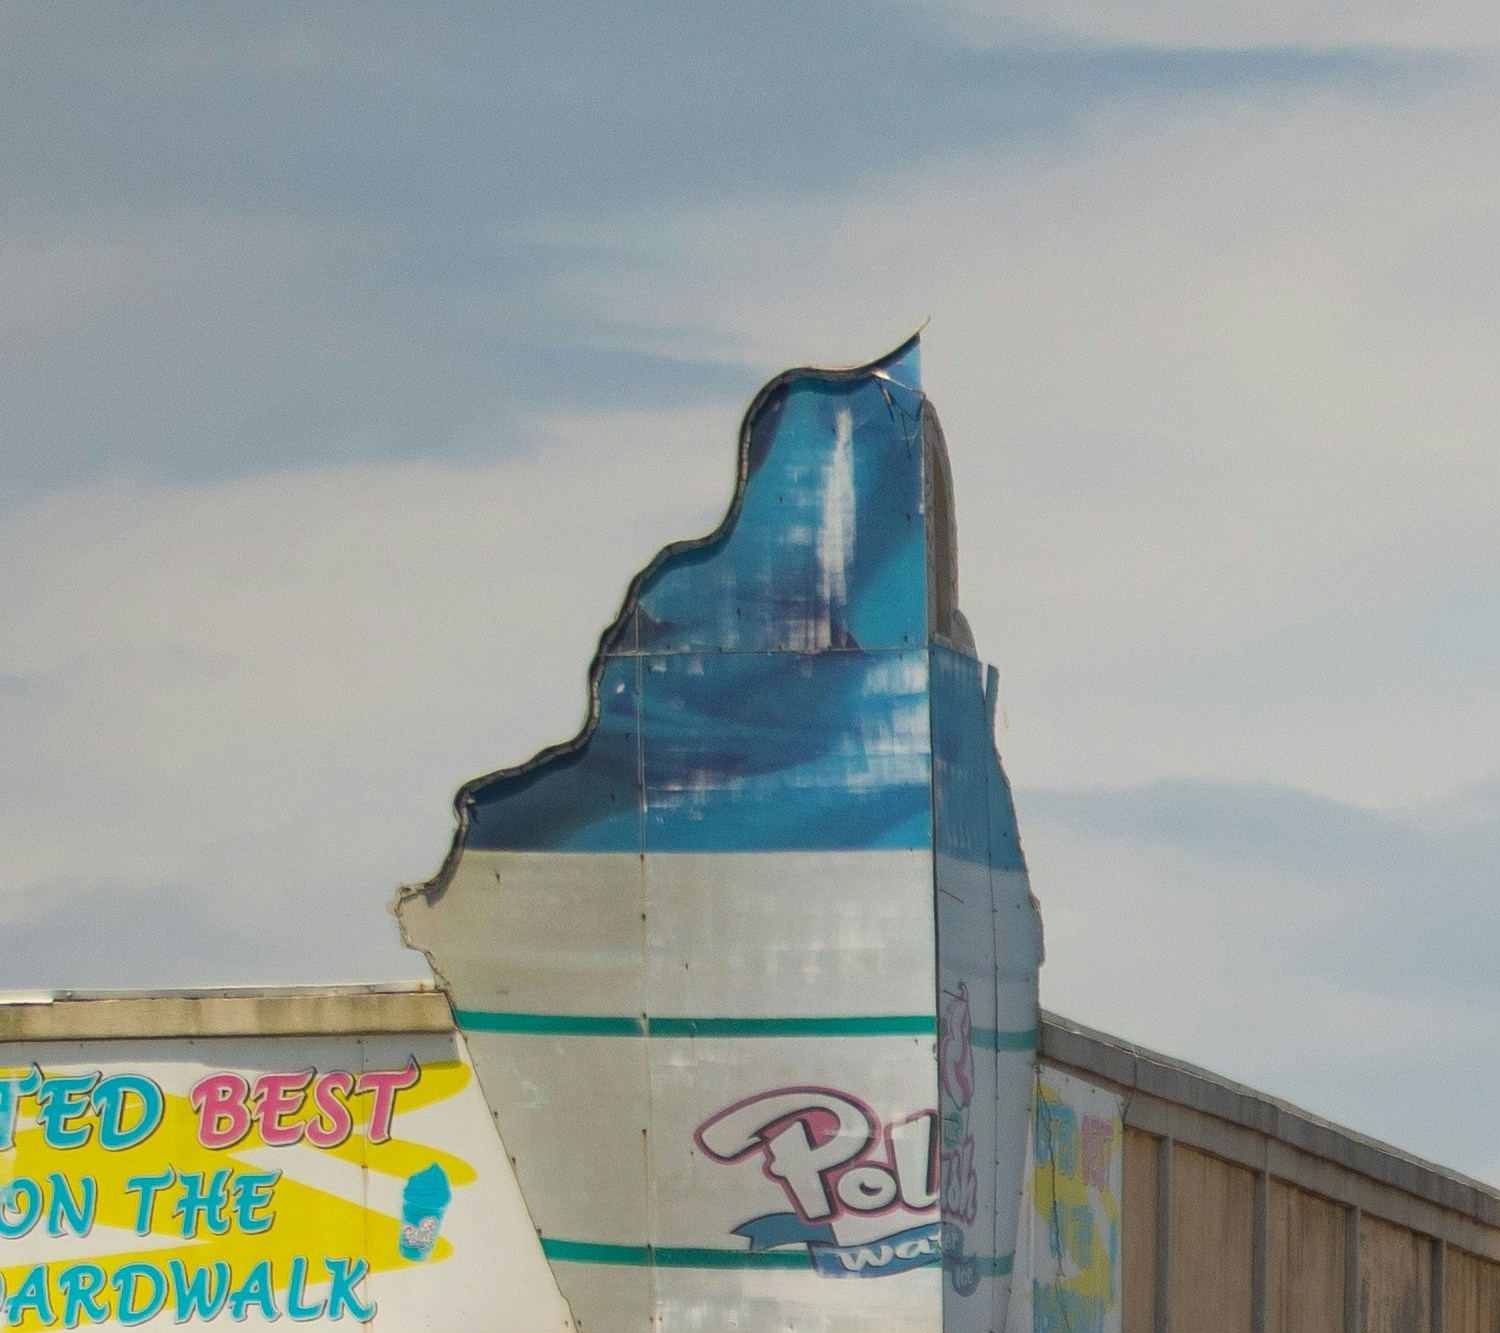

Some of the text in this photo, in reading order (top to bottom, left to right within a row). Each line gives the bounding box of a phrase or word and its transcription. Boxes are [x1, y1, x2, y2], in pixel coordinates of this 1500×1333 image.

[191, 1055, 420, 1149] BEST
[126, 1165, 283, 1238] THE
[0, 1256, 376, 1329] ARDWALK
